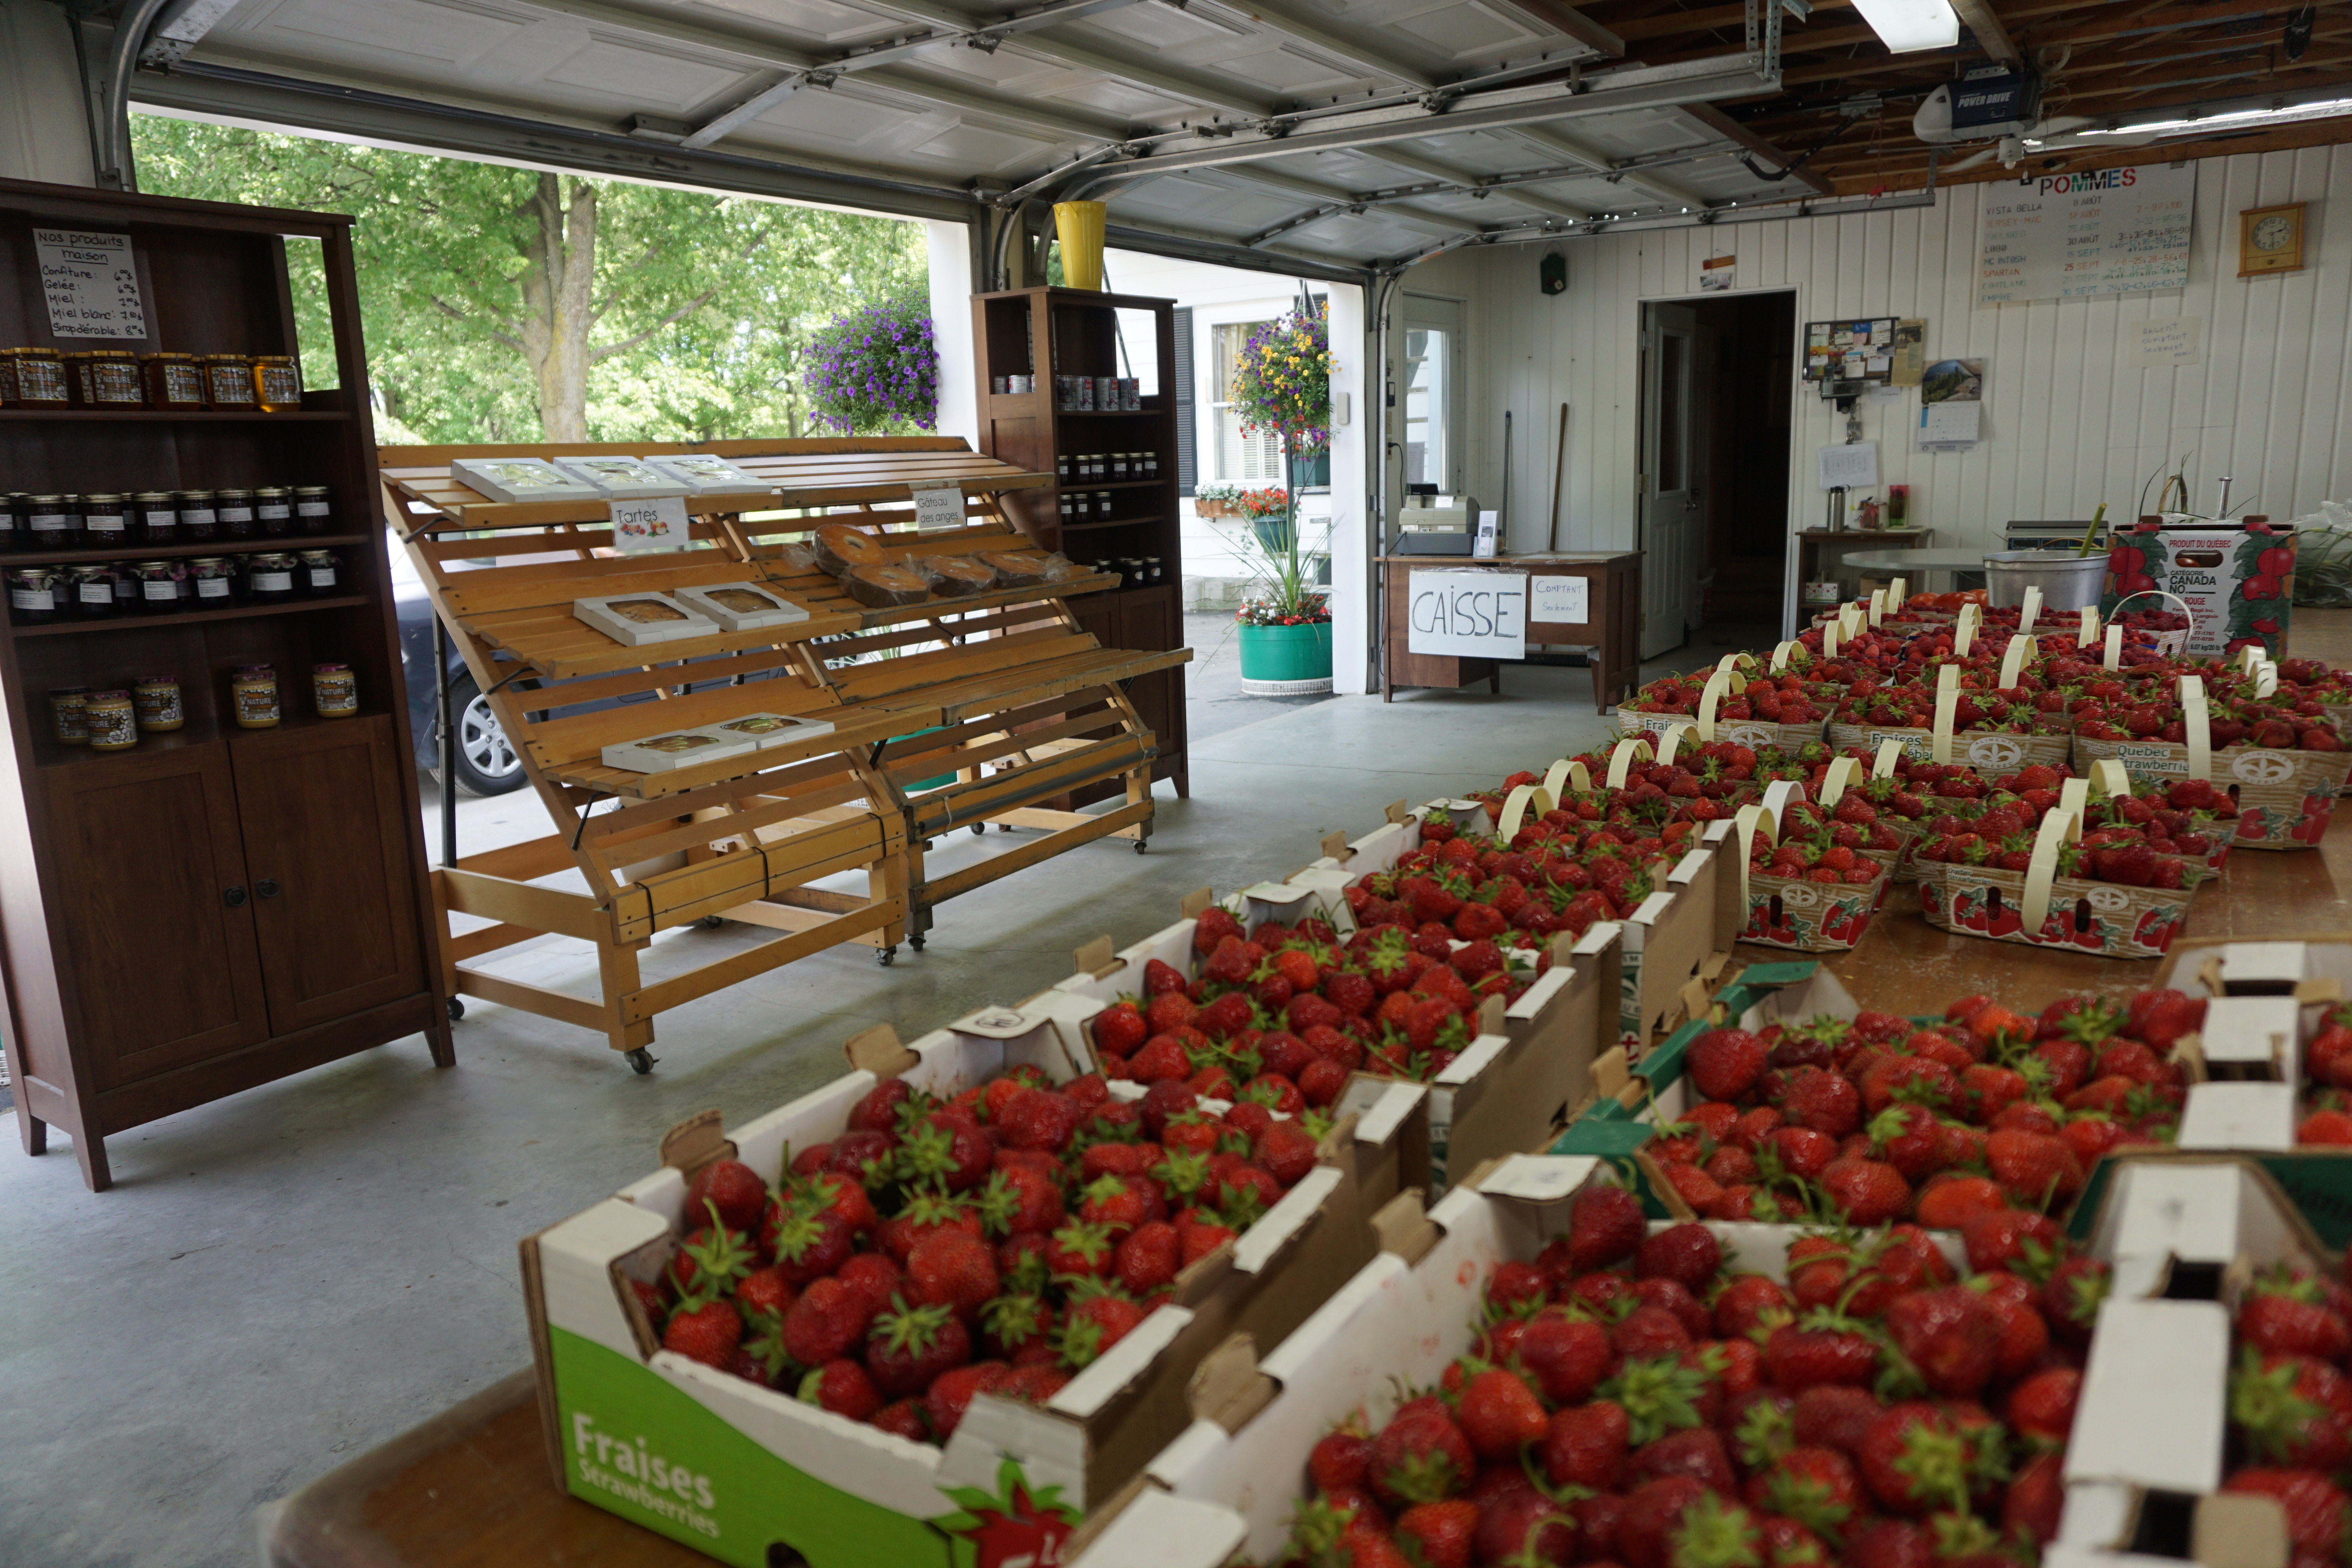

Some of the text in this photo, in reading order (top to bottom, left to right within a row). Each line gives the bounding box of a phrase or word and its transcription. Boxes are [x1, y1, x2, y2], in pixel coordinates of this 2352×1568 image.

[1957, 95, 1986, 108] POWER
[1985, 91, 2011, 104] DRIVE
[2040, 169, 2136, 196] POMMES
[1987, 206, 2011, 215] VISTA
[2016, 203, 2042, 212] BELLA
[39, 232, 123, 247] Nos produits
[2067, 237, 2077, 246] 30
[62, 249, 109, 262] maison
[2078, 248, 2101, 257] SEPT
[1983, 268, 2020, 278] SPARTAN
[2064, 263, 2074, 272] 25
[2077, 260, 2100, 270] SEPT
[48, 292, 75, 306] Miel
[1981, 293, 2012, 303] EMPIRE
[2075, 285, 2098, 295] SEPT
[52, 308, 77, 320] Miel
[26, 373, 57, 381] NATURE
[103, 375, 131, 384] NATURE
[918, 497, 947, 508] Gâteau
[616, 508, 658, 524] Tartes
[920, 511, 958, 523] des anges
[2207, 538, 2232, 548] QUÉBEC
[2170, 575, 2217, 585] CANADA
[1535, 580, 1584, 595] COMPTANT
[2169, 584, 2189, 594] NO.
[1733, 726, 1768, 736] ALIMENTS
[1975, 738, 2016, 748] ALIMENTS
[2118, 745, 2169, 757] Quebec
[2119, 758, 2189, 771] trawberrie
[1948, 875, 1992, 884] Strawberries
[572, 1412, 715, 1510] Fraises
[579, 1457, 720, 1539] Strawberries
